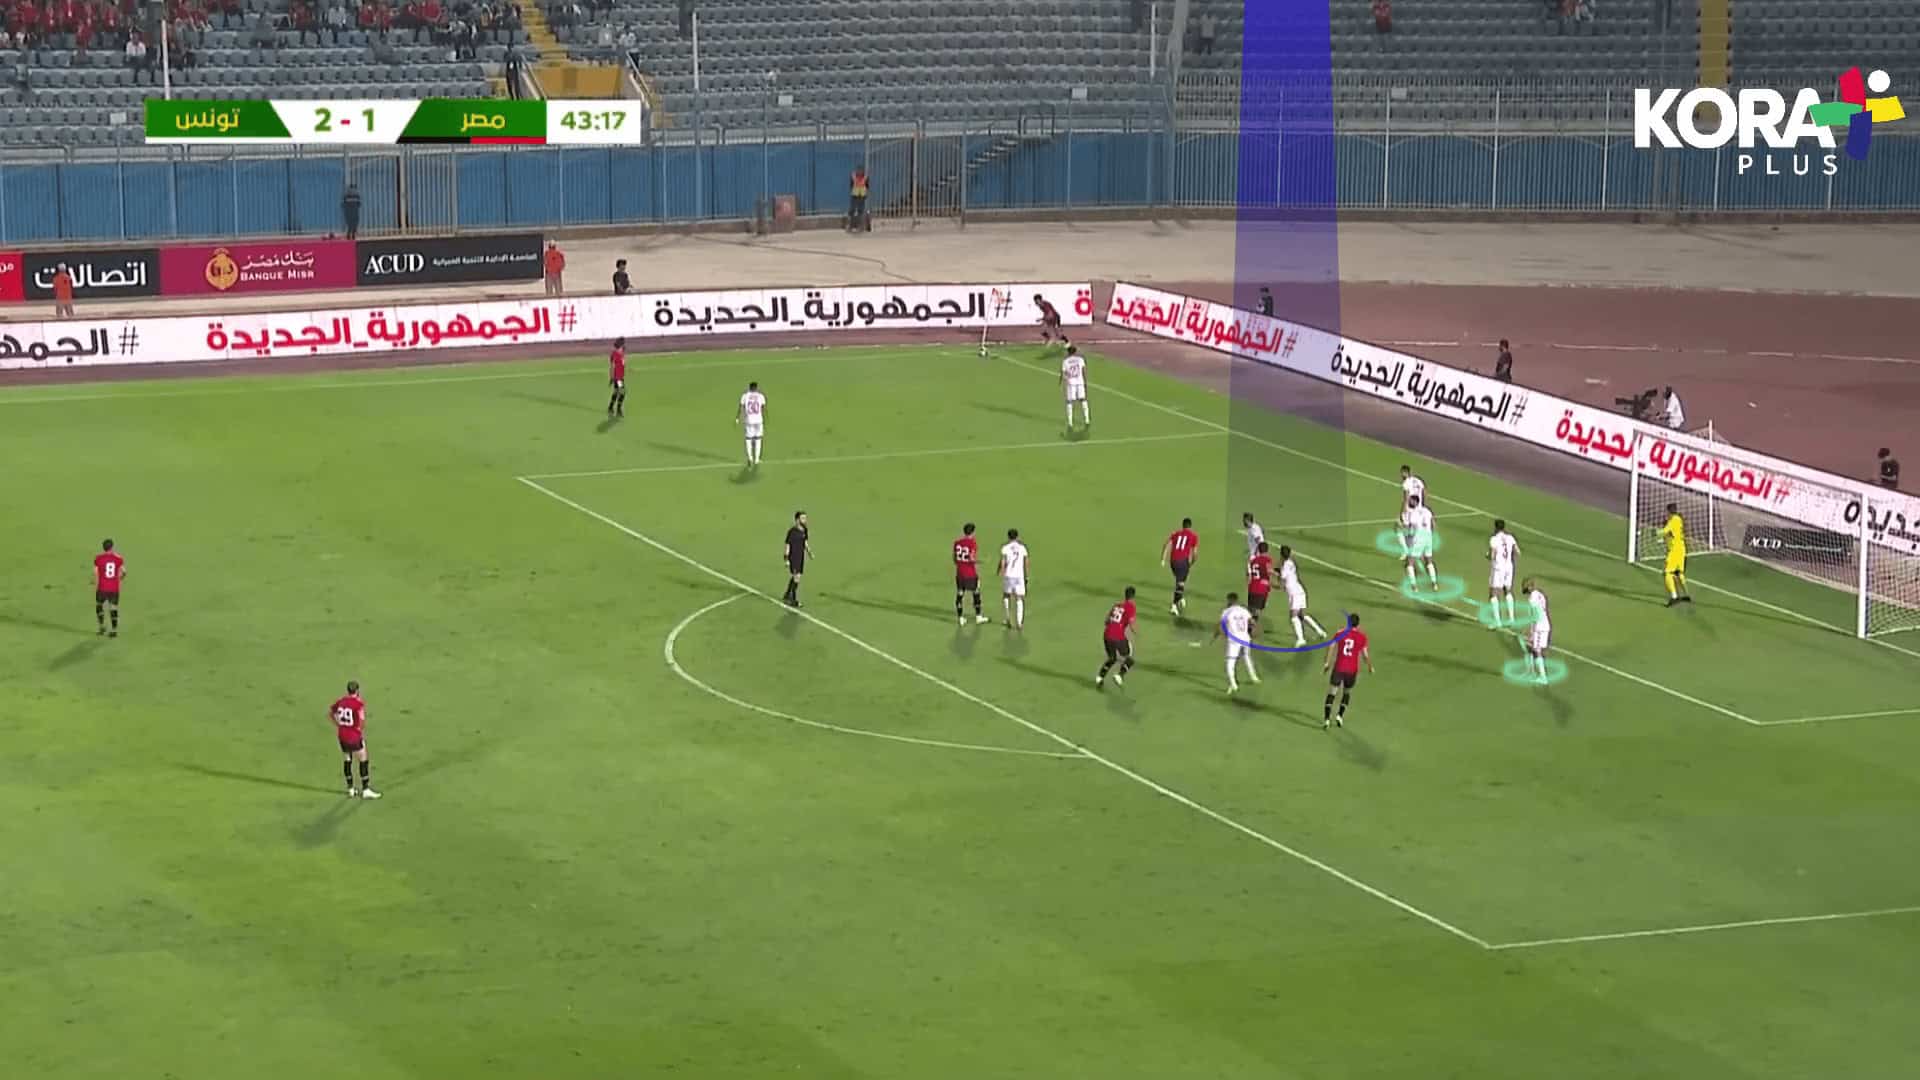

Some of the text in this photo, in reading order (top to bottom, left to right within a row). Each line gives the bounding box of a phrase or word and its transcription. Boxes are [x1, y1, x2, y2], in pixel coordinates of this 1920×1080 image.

[364, 253, 425, 275] ACUD
[206, 305, 578, 355] #الجمهورية_الجديدة
[1331, 345, 1528, 425] #الجمهورية_الجديدة
[1175, 535, 1188, 550] 11
[955, 544, 970, 562] 22
[105, 561, 116, 579] 8
[1343, 638, 1354, 657] 2
[336, 706, 354, 726] 29
